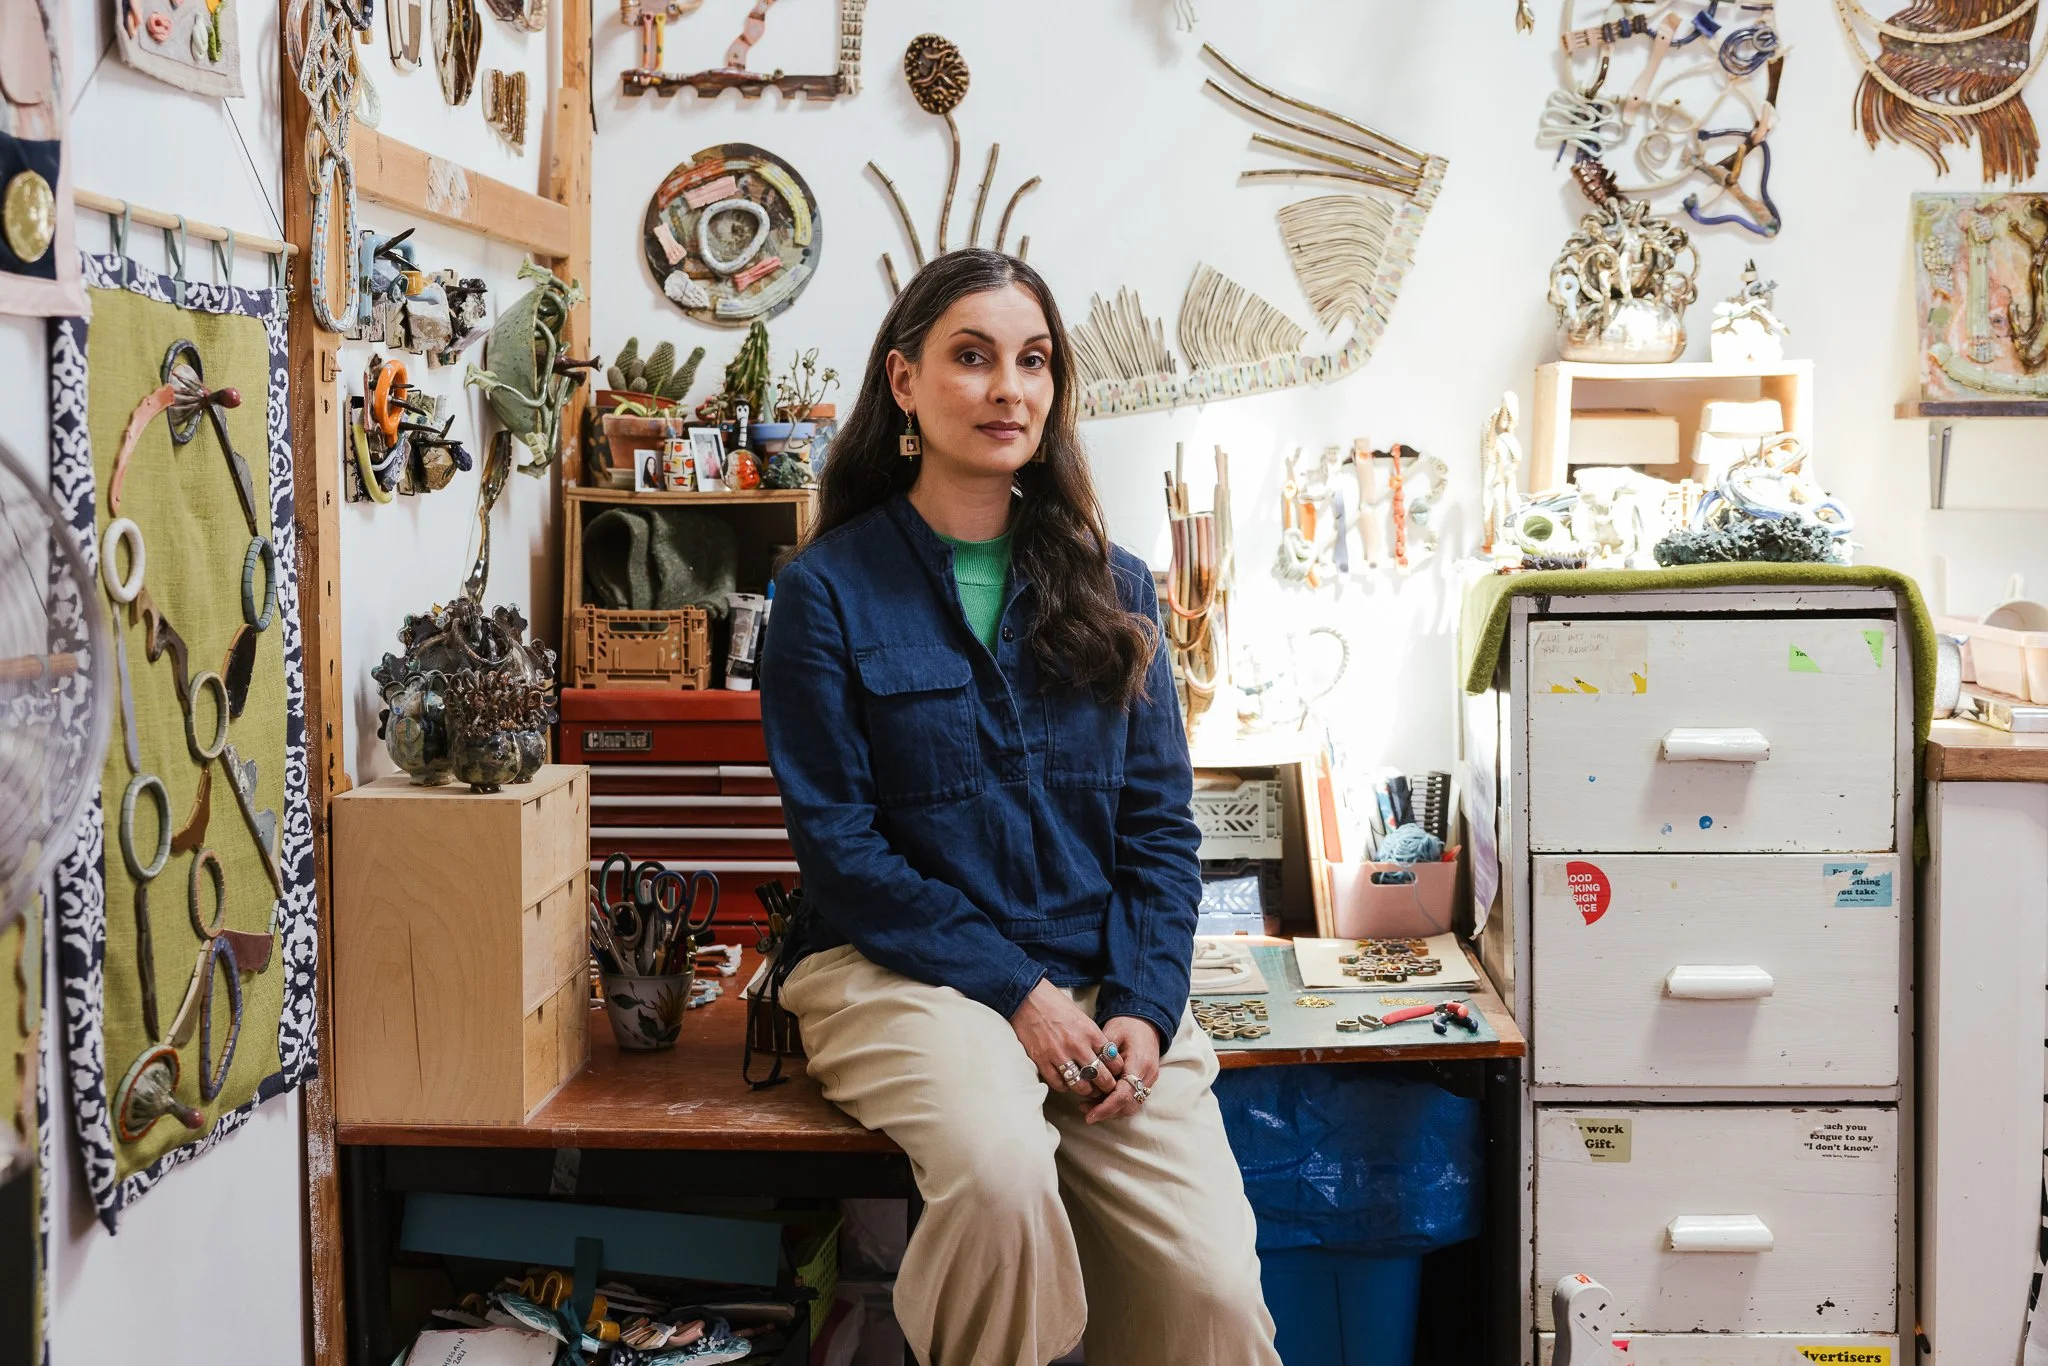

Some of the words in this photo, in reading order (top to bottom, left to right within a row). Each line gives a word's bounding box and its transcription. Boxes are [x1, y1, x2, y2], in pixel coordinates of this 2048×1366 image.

[588, 732, 647, 748] Clarke
[1852, 868, 1864, 876] do
[1850, 878, 1881, 887] ething
[1855, 888, 1878, 896] take.
[1586, 1124, 1624, 1134] work
[1585, 1138, 1615, 1149] Gift.
[1857, 1135, 1874, 1143] say
[1804, 1142, 1813, 1150] "I
[1815, 1143, 1841, 1151] don't
[1843, 1144, 1879, 1152] know."
